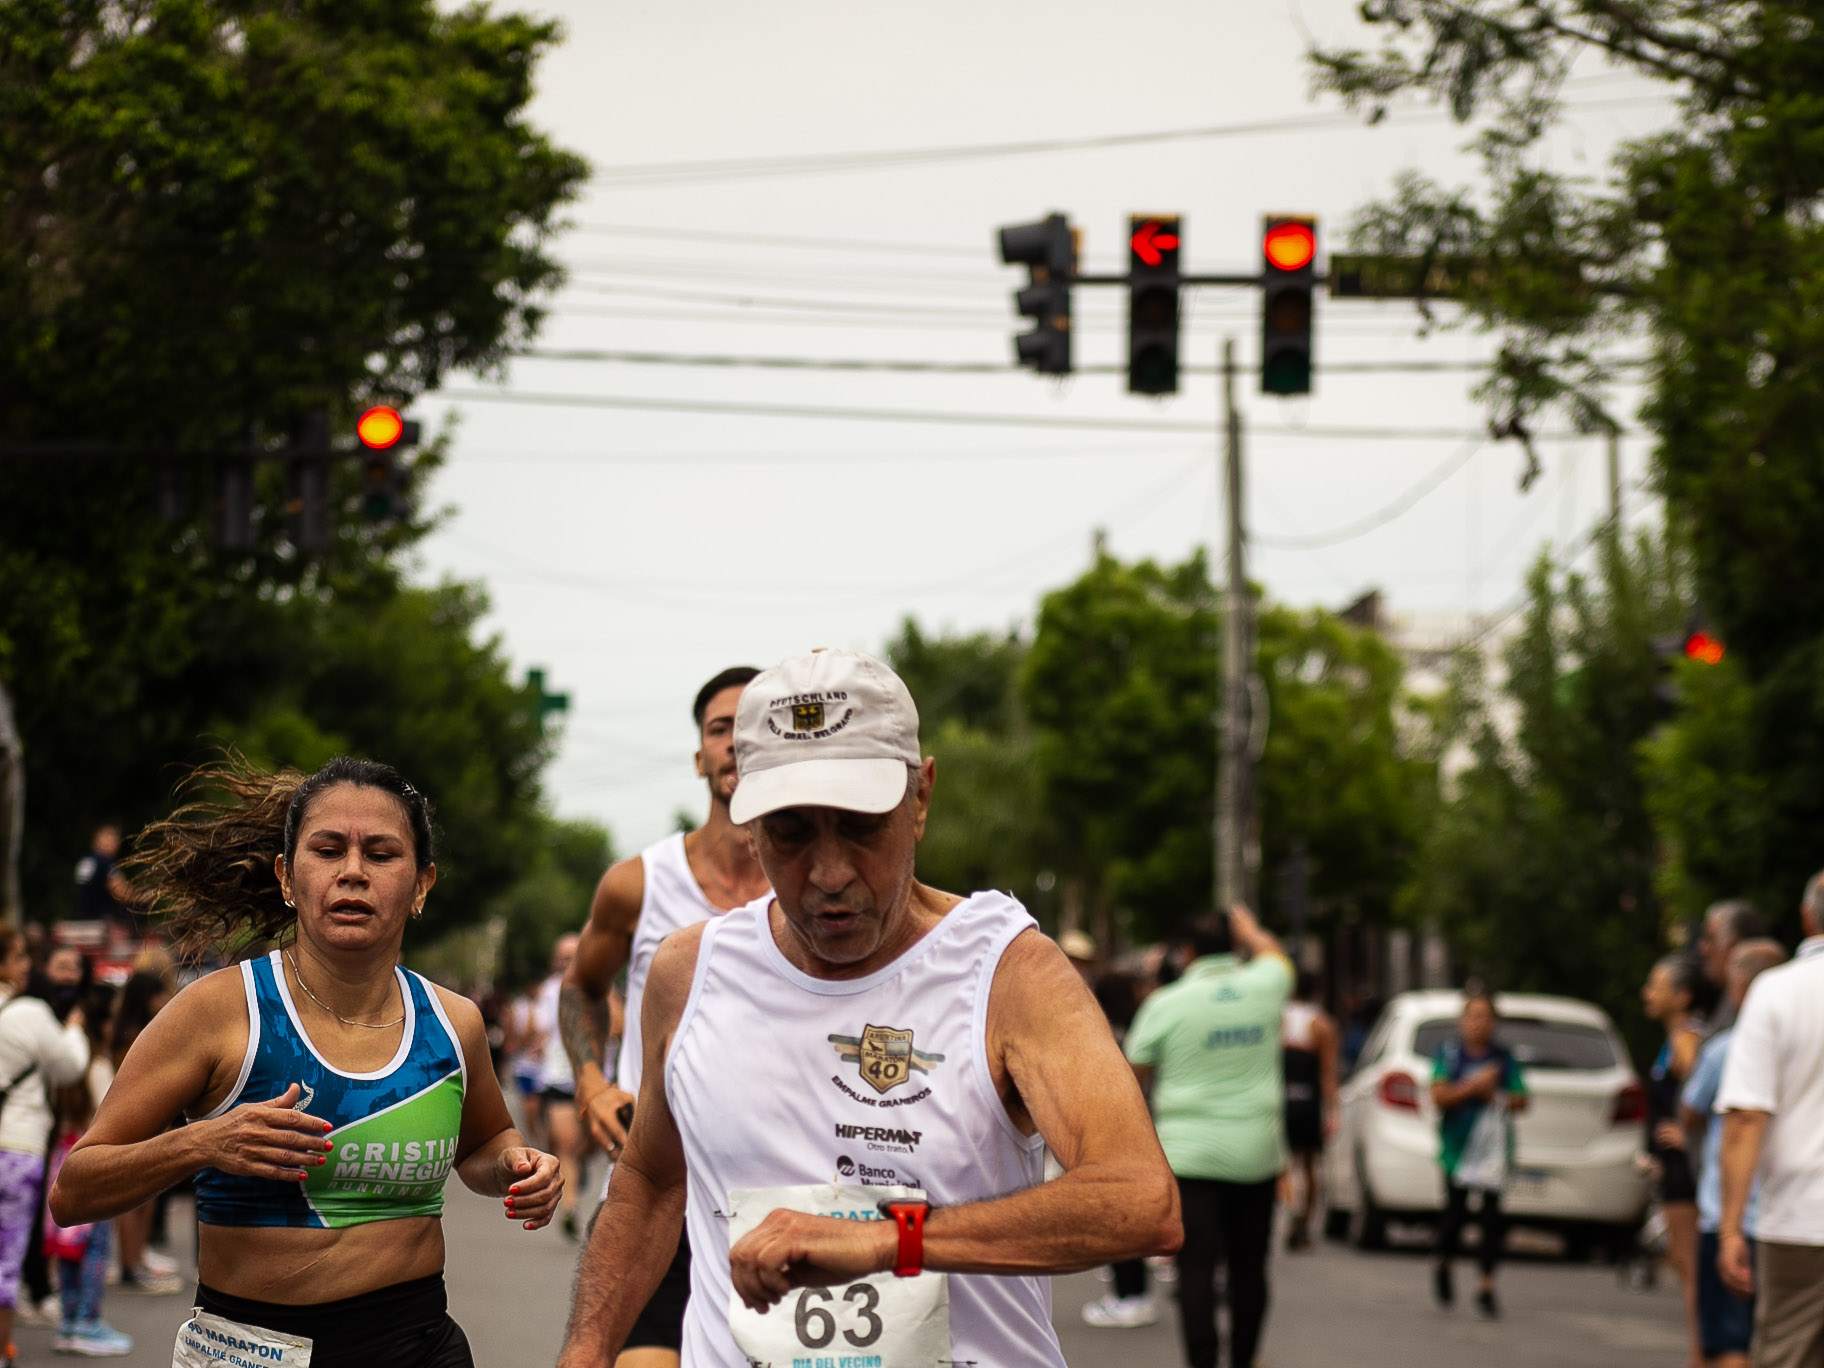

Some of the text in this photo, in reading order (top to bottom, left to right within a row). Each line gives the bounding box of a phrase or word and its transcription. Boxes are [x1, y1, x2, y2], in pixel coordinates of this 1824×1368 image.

[868, 1060, 899, 1079] 40
[831, 1075, 932, 1108] EMPALME GRANEROS
[339, 1136, 459, 1162] CRISTIA
[866, 1142, 886, 1152] Otro
[858, 1164, 896, 1179] Banco
[327, 1181, 422, 1197] RUNNING
[794, 1283, 884, 1349] 63
[184, 1335, 227, 1361] EMPALME
[205, 1328, 284, 1362] MARATON
